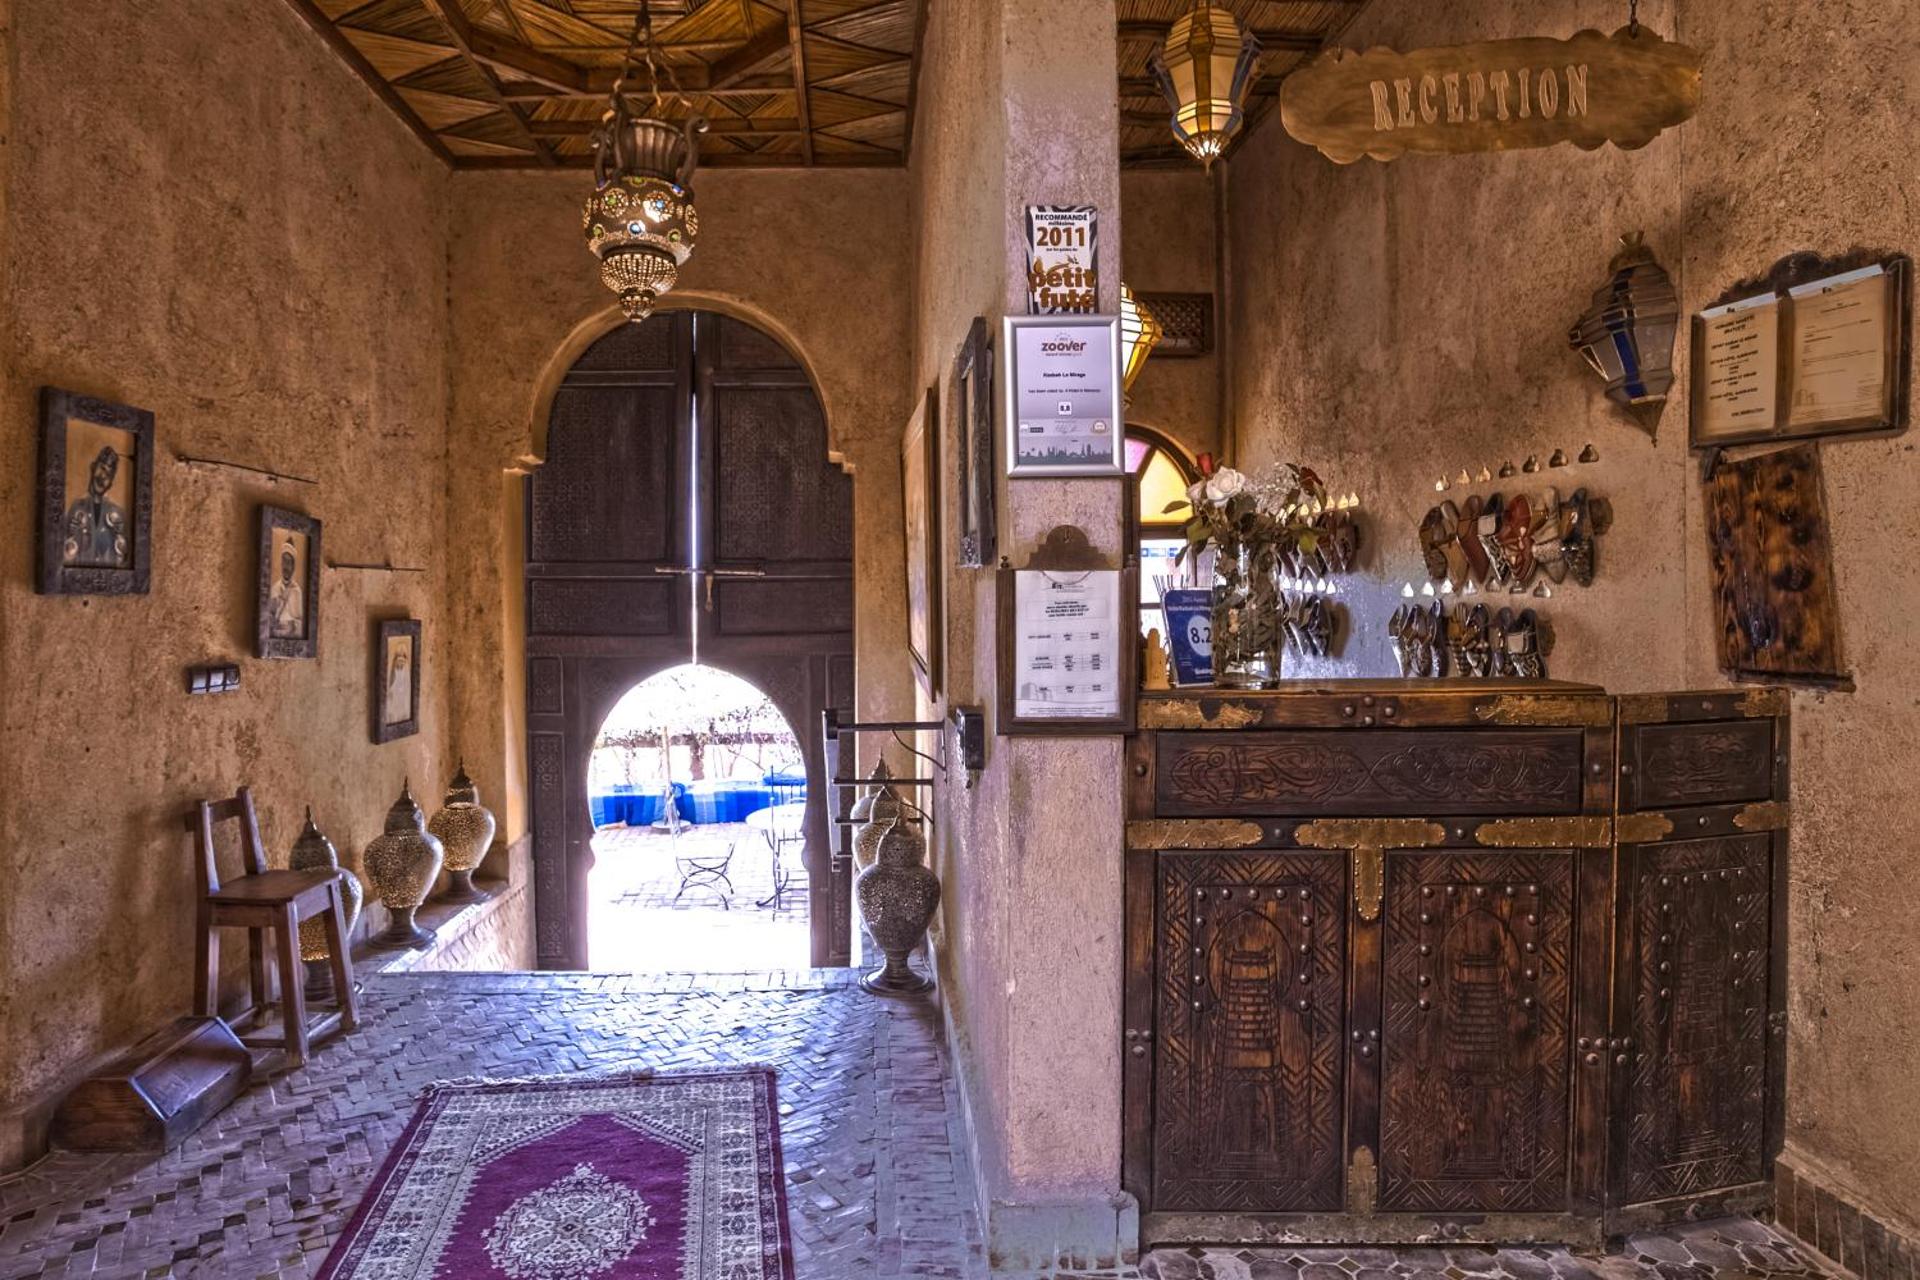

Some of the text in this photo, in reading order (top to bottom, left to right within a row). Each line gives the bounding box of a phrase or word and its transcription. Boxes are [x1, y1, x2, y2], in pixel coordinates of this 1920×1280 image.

[1370, 64, 1588, 131] RECEPTION
[1036, 226, 1085, 247] 2011
[1028, 266, 1096, 293] petit
[1039, 287, 1095, 308] futé
[1041, 341, 1087, 352] zoover
